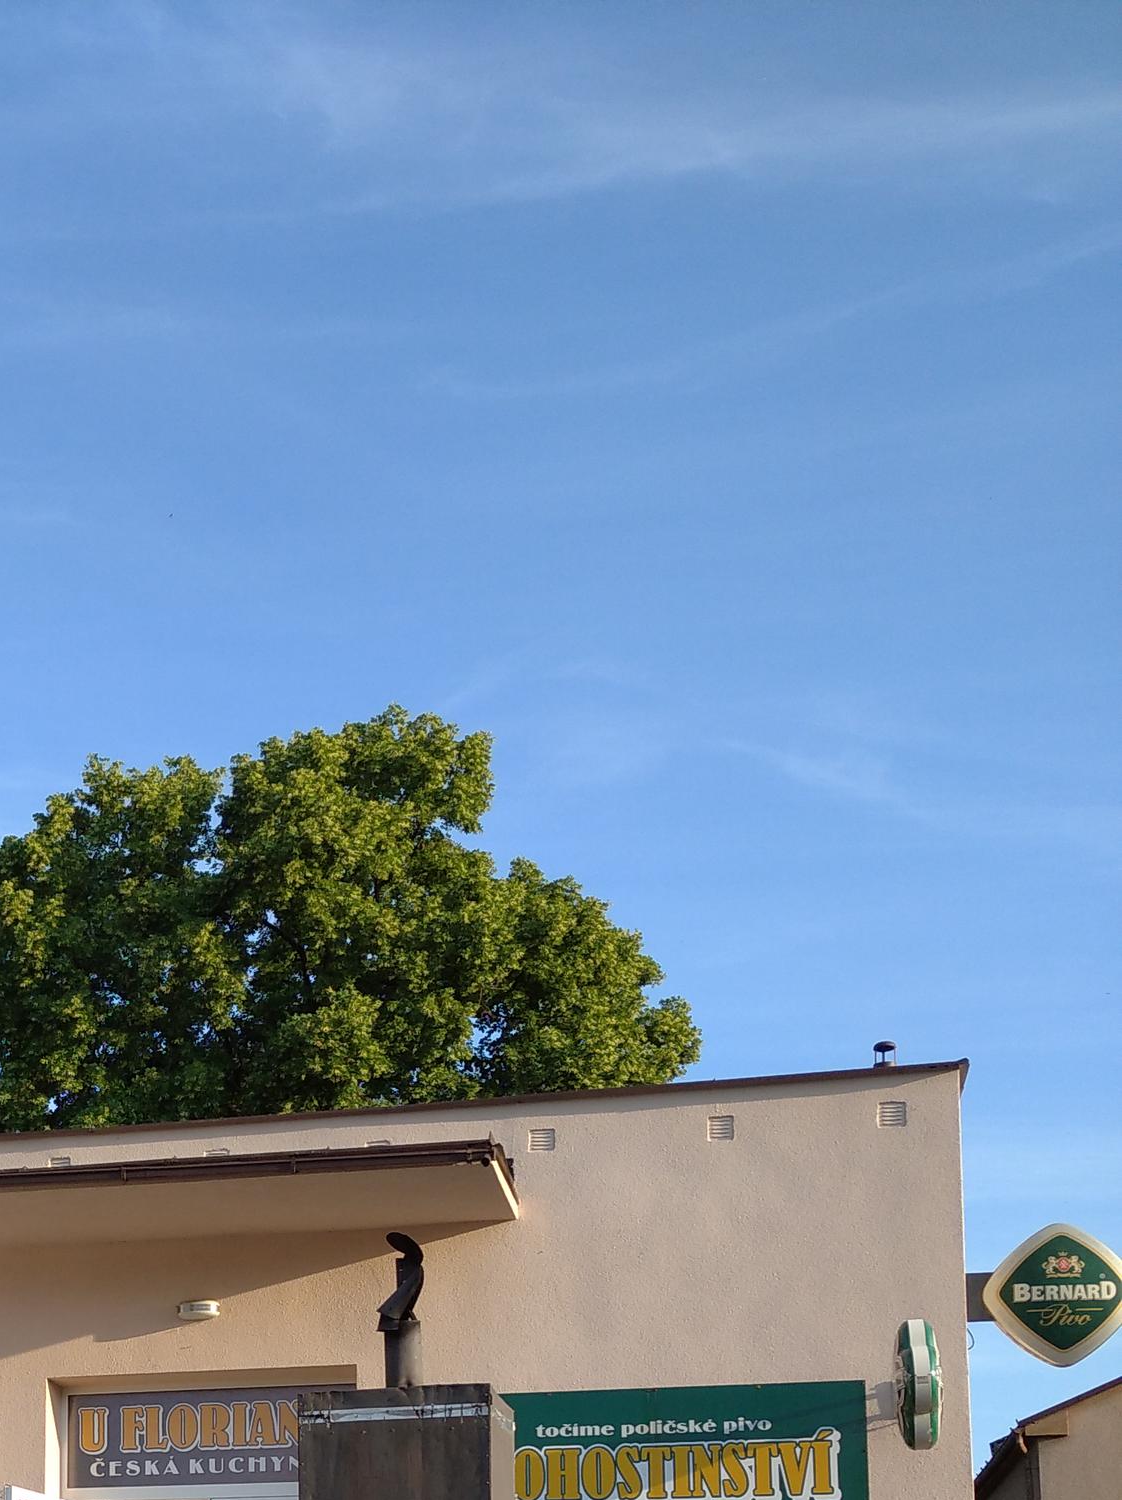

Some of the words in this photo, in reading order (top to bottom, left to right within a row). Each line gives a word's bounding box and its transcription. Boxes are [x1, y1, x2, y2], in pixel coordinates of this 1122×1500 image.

[1013, 1280, 1117, 1303] BERNARD
[1039, 1303, 1092, 1326] Pivo
[79, 1406, 109, 1455] U
[119, 1400, 299, 1453] FLORIAN
[535, 1422, 615, 1438] točíme
[621, 1418, 717, 1439] poličské
[723, 1416, 772, 1435] pivo
[89, 1456, 179, 1477] ČESKÁ
